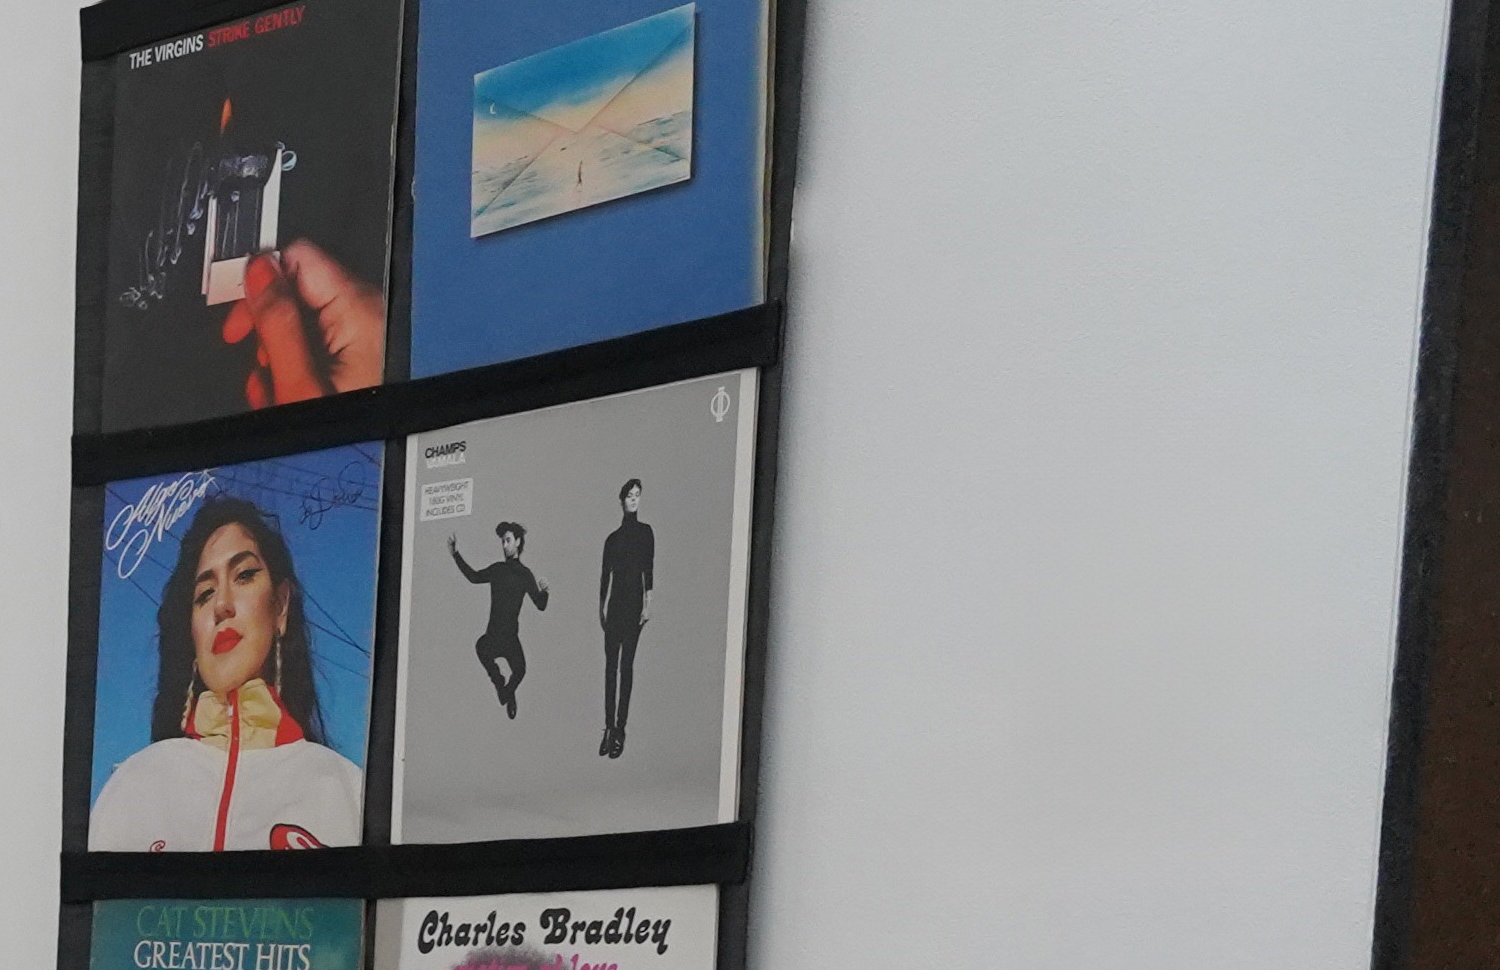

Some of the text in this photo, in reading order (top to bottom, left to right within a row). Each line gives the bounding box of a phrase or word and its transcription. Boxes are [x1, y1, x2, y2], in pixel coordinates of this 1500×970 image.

[129, 49, 152, 69] THE
[154, 34, 204, 63] VIRGINS
[425, 440, 466, 458] CHAMPS
[137, 905, 314, 940] CAT STEVENS
[417, 907, 672, 955] Charles Bradley
